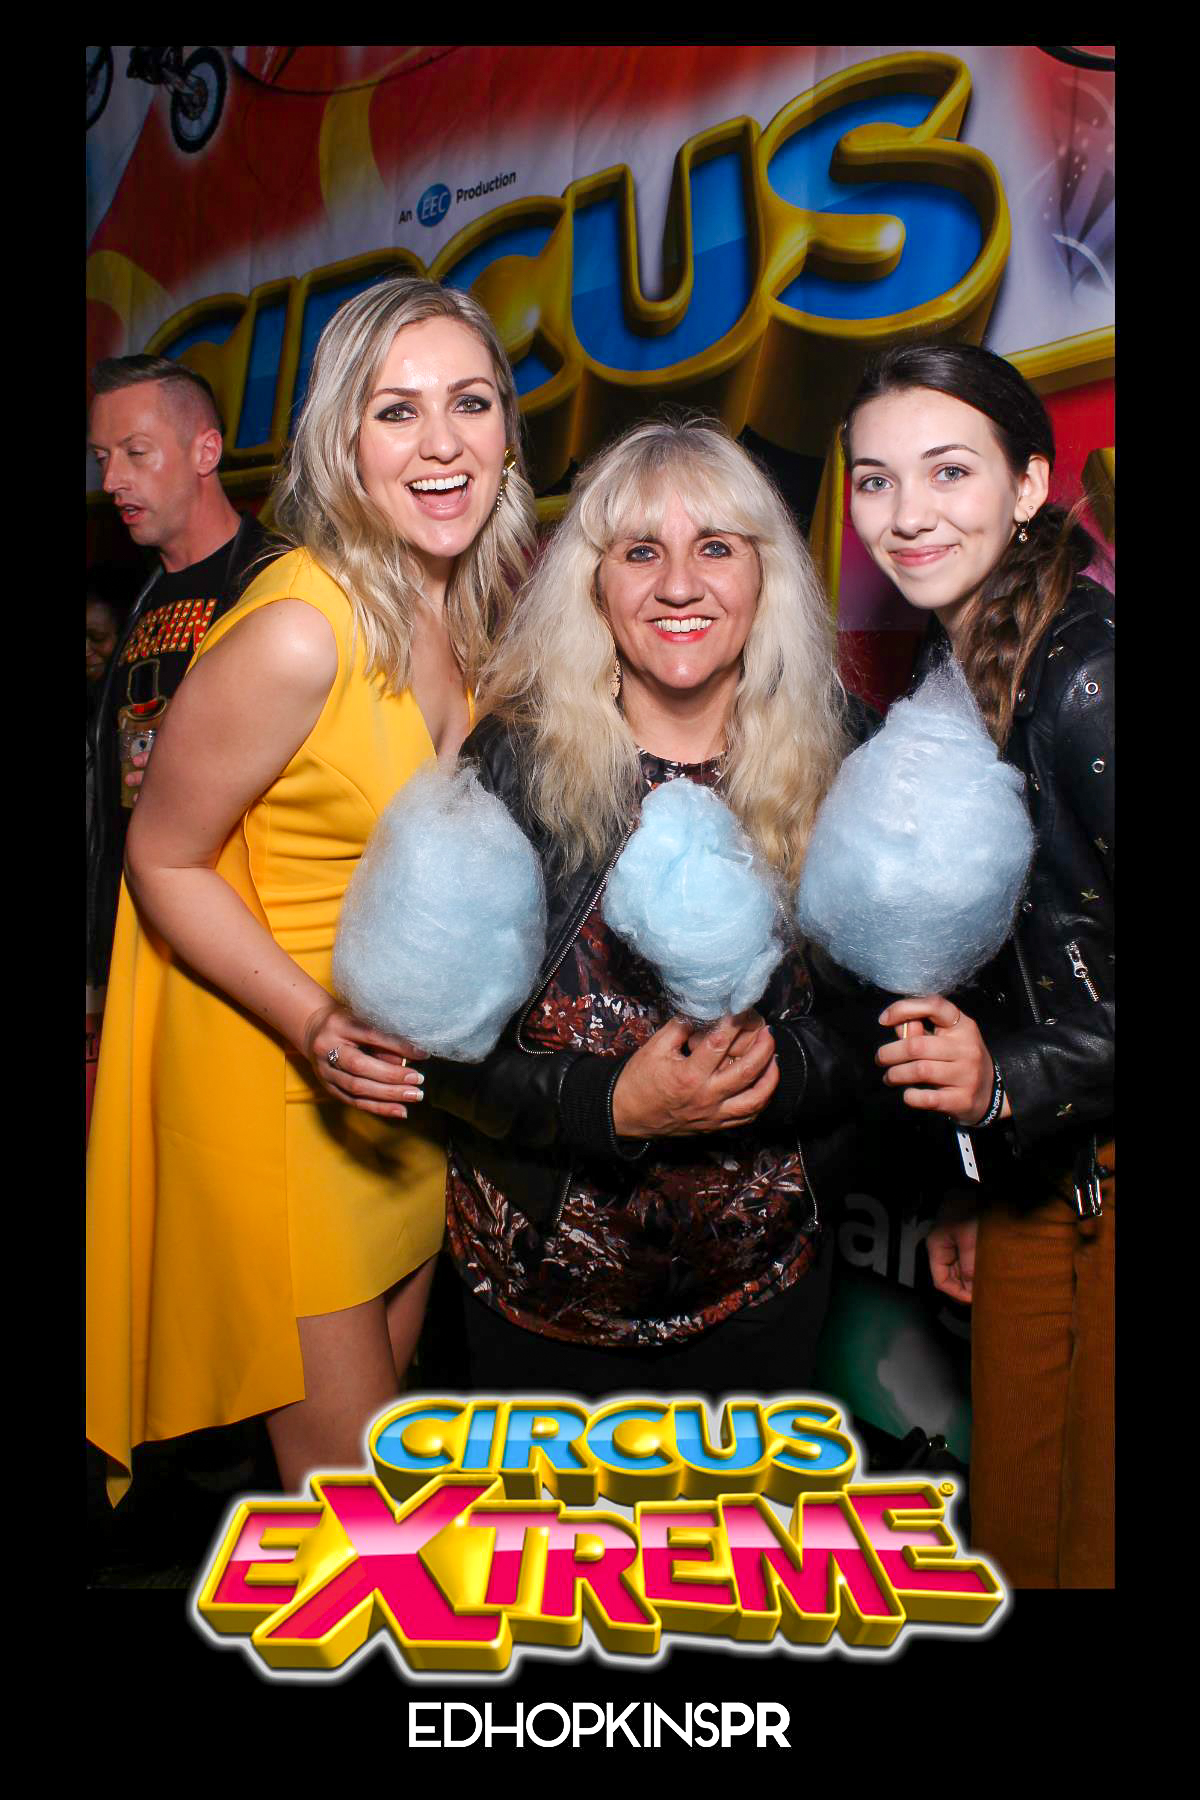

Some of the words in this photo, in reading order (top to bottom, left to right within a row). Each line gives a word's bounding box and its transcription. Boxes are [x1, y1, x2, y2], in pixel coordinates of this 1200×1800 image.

[399, 210, 413, 224] An
[421, 191, 449, 220] EEC
[456, 171, 517, 204] Production
